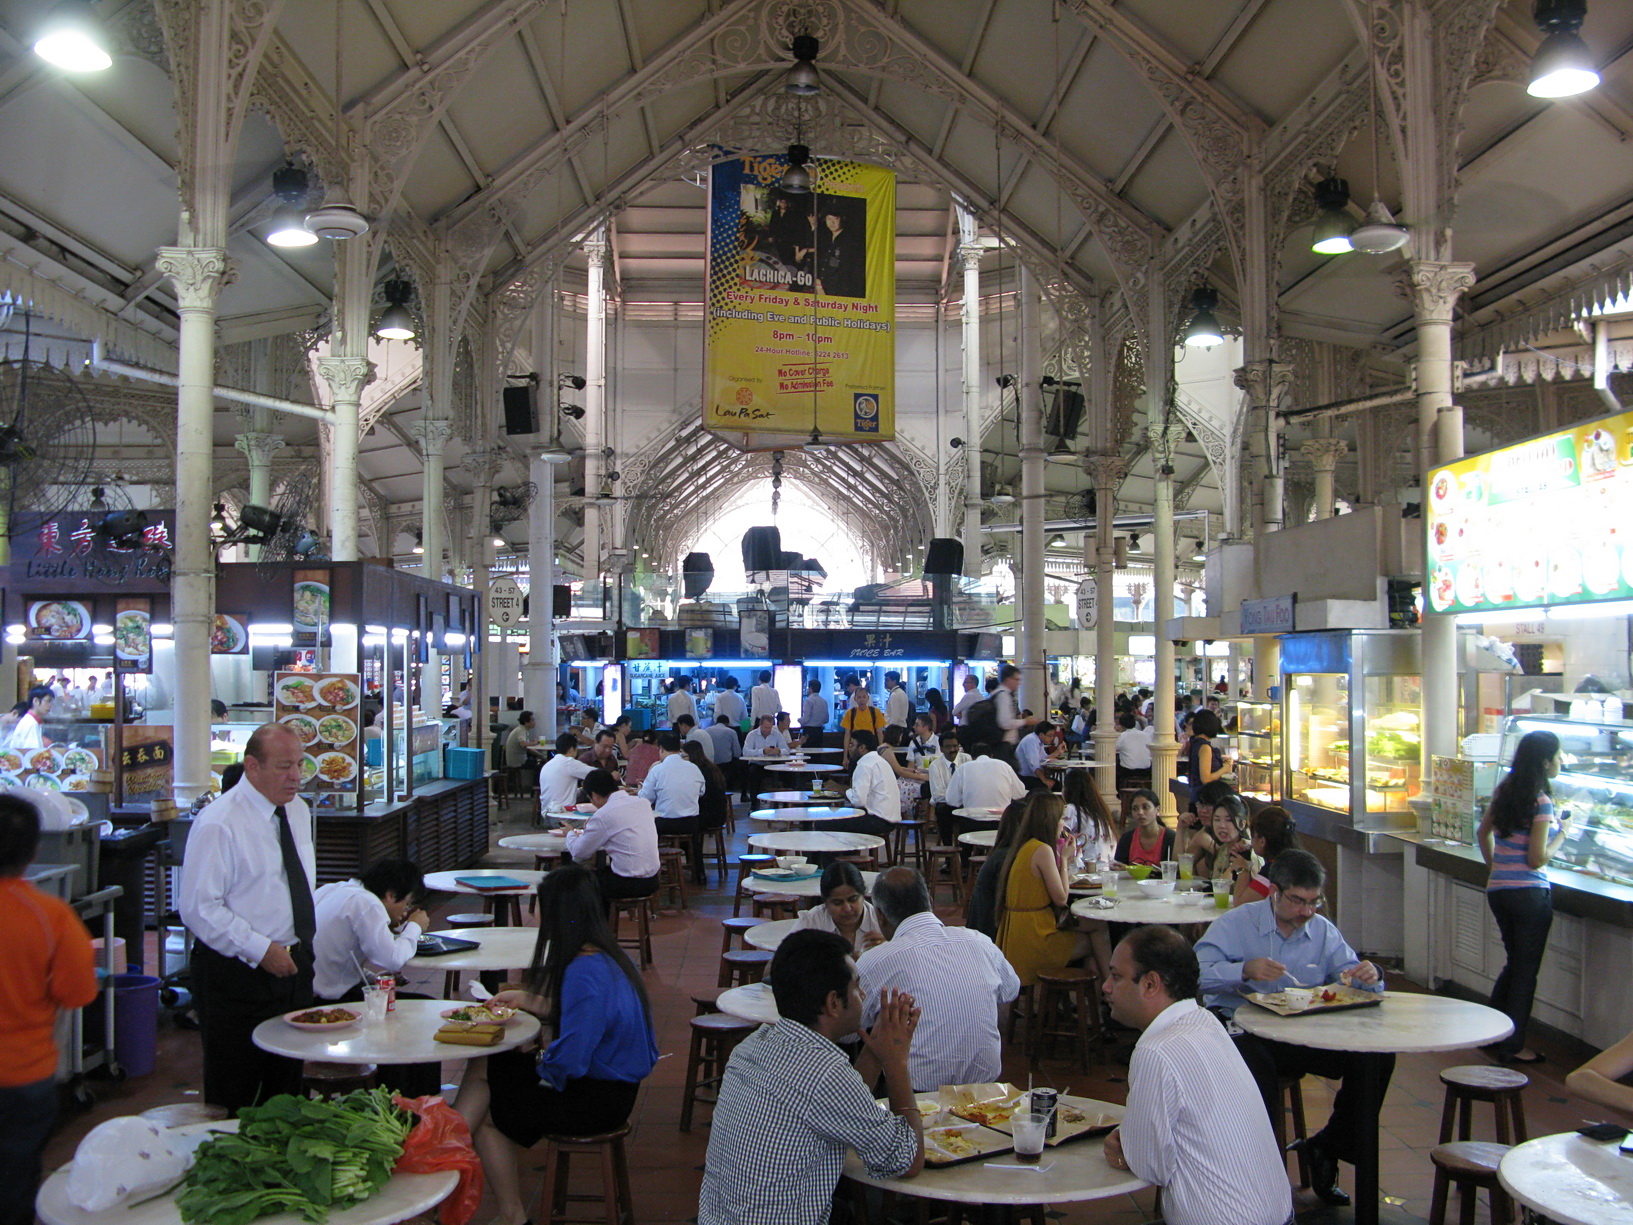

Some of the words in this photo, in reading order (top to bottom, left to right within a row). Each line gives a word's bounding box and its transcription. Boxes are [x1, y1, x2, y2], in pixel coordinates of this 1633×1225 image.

[740, 156, 790, 184] Tiger
[726, 291, 756, 304] Every
[758, 294, 790, 307] Friday
[793, 297, 801, 306] &
[804, 298, 849, 312] Saturday
[851, 302, 879, 314] Night
[713, 307, 764, 323] (including
[766, 311, 787, 322] Eve
[788, 315, 807, 325] and
[810, 315, 841, 328] Public
[843, 318, 891, 332] Holidays)
[772, 330, 794, 341] 8pm
[805, 333, 833, 344] 10pm
[755, 346, 784, 355] 24-Hour
[785, 348, 813, 357] Hotline:
[778, 368, 788, 377] No
[788, 368, 806, 377] Cover
[779, 382, 789, 390] No
[822, 379, 834, 388] Fee
[715, 404, 737, 417] Lau
[738, 407, 750, 419] Pa
[752, 408, 776, 420] Sat
[856, 418, 877, 430] Tiger
[26, 558, 77, 579] Little
[83, 558, 129, 584] Hong
[494, 586, 503, 594] 43
[507, 587, 516, 595] 57
[491, 597, 515, 609] STREET
[515, 597, 520, 609] 4
[1078, 597, 1095, 609] STREET
[1515, 623, 1535, 635] STALL
[863, 632, 893, 649] 果汁
[849, 648, 880, 658] JUICE
[883, 648, 905, 657] BAR
